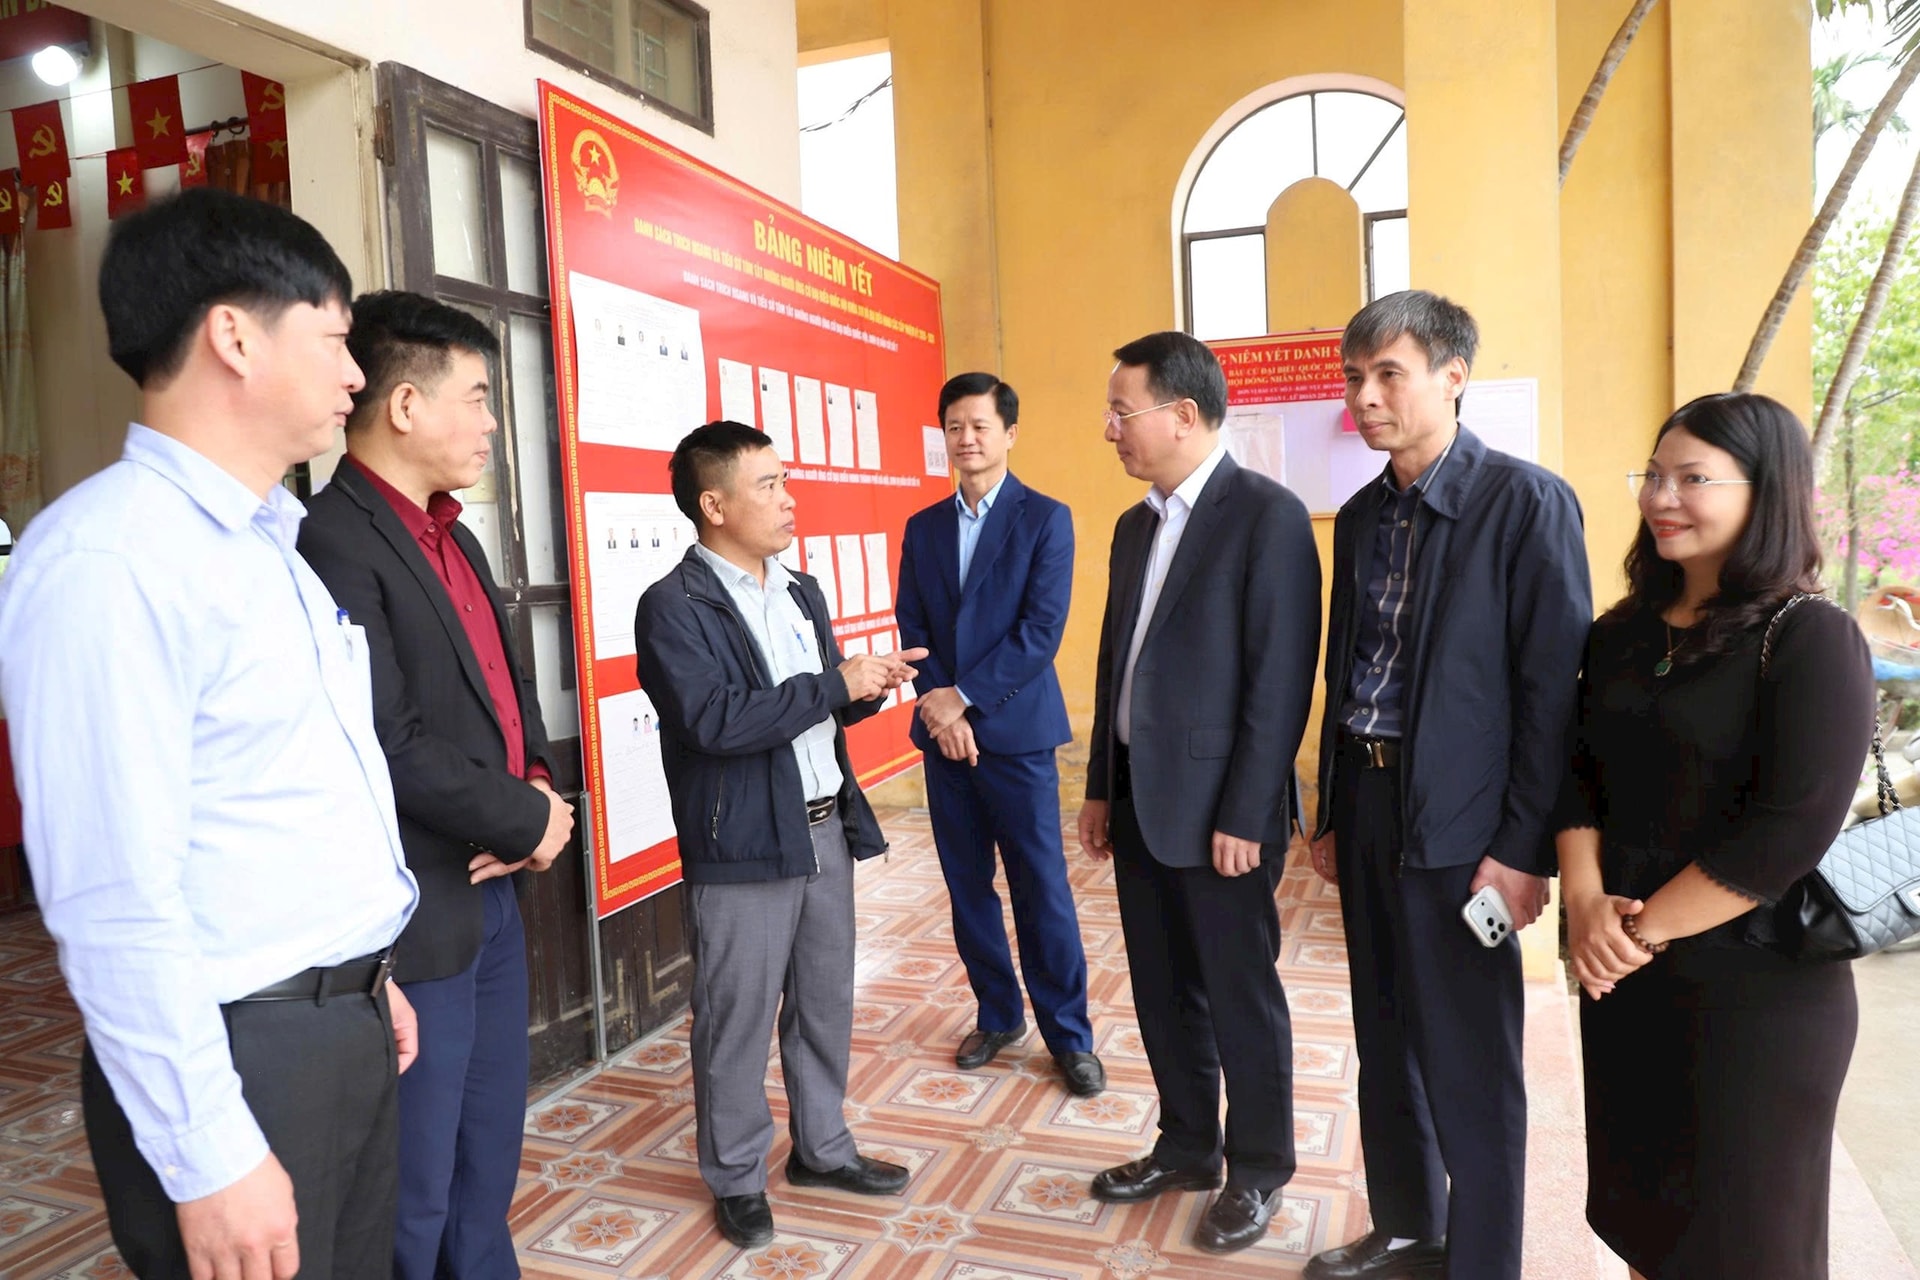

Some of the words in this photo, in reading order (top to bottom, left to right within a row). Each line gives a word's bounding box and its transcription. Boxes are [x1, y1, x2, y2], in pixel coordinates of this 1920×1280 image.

[754, 213, 803, 268] BẢNG
[806, 243, 846, 287] NIÊM
[849, 261, 873, 297] YẾT
[1230, 349, 1262, 364] NIÊM
[1265, 347, 1290, 362] YẾT
[1294, 346, 1330, 360] DANH
[1299, 361, 1321, 374] QUỐC
